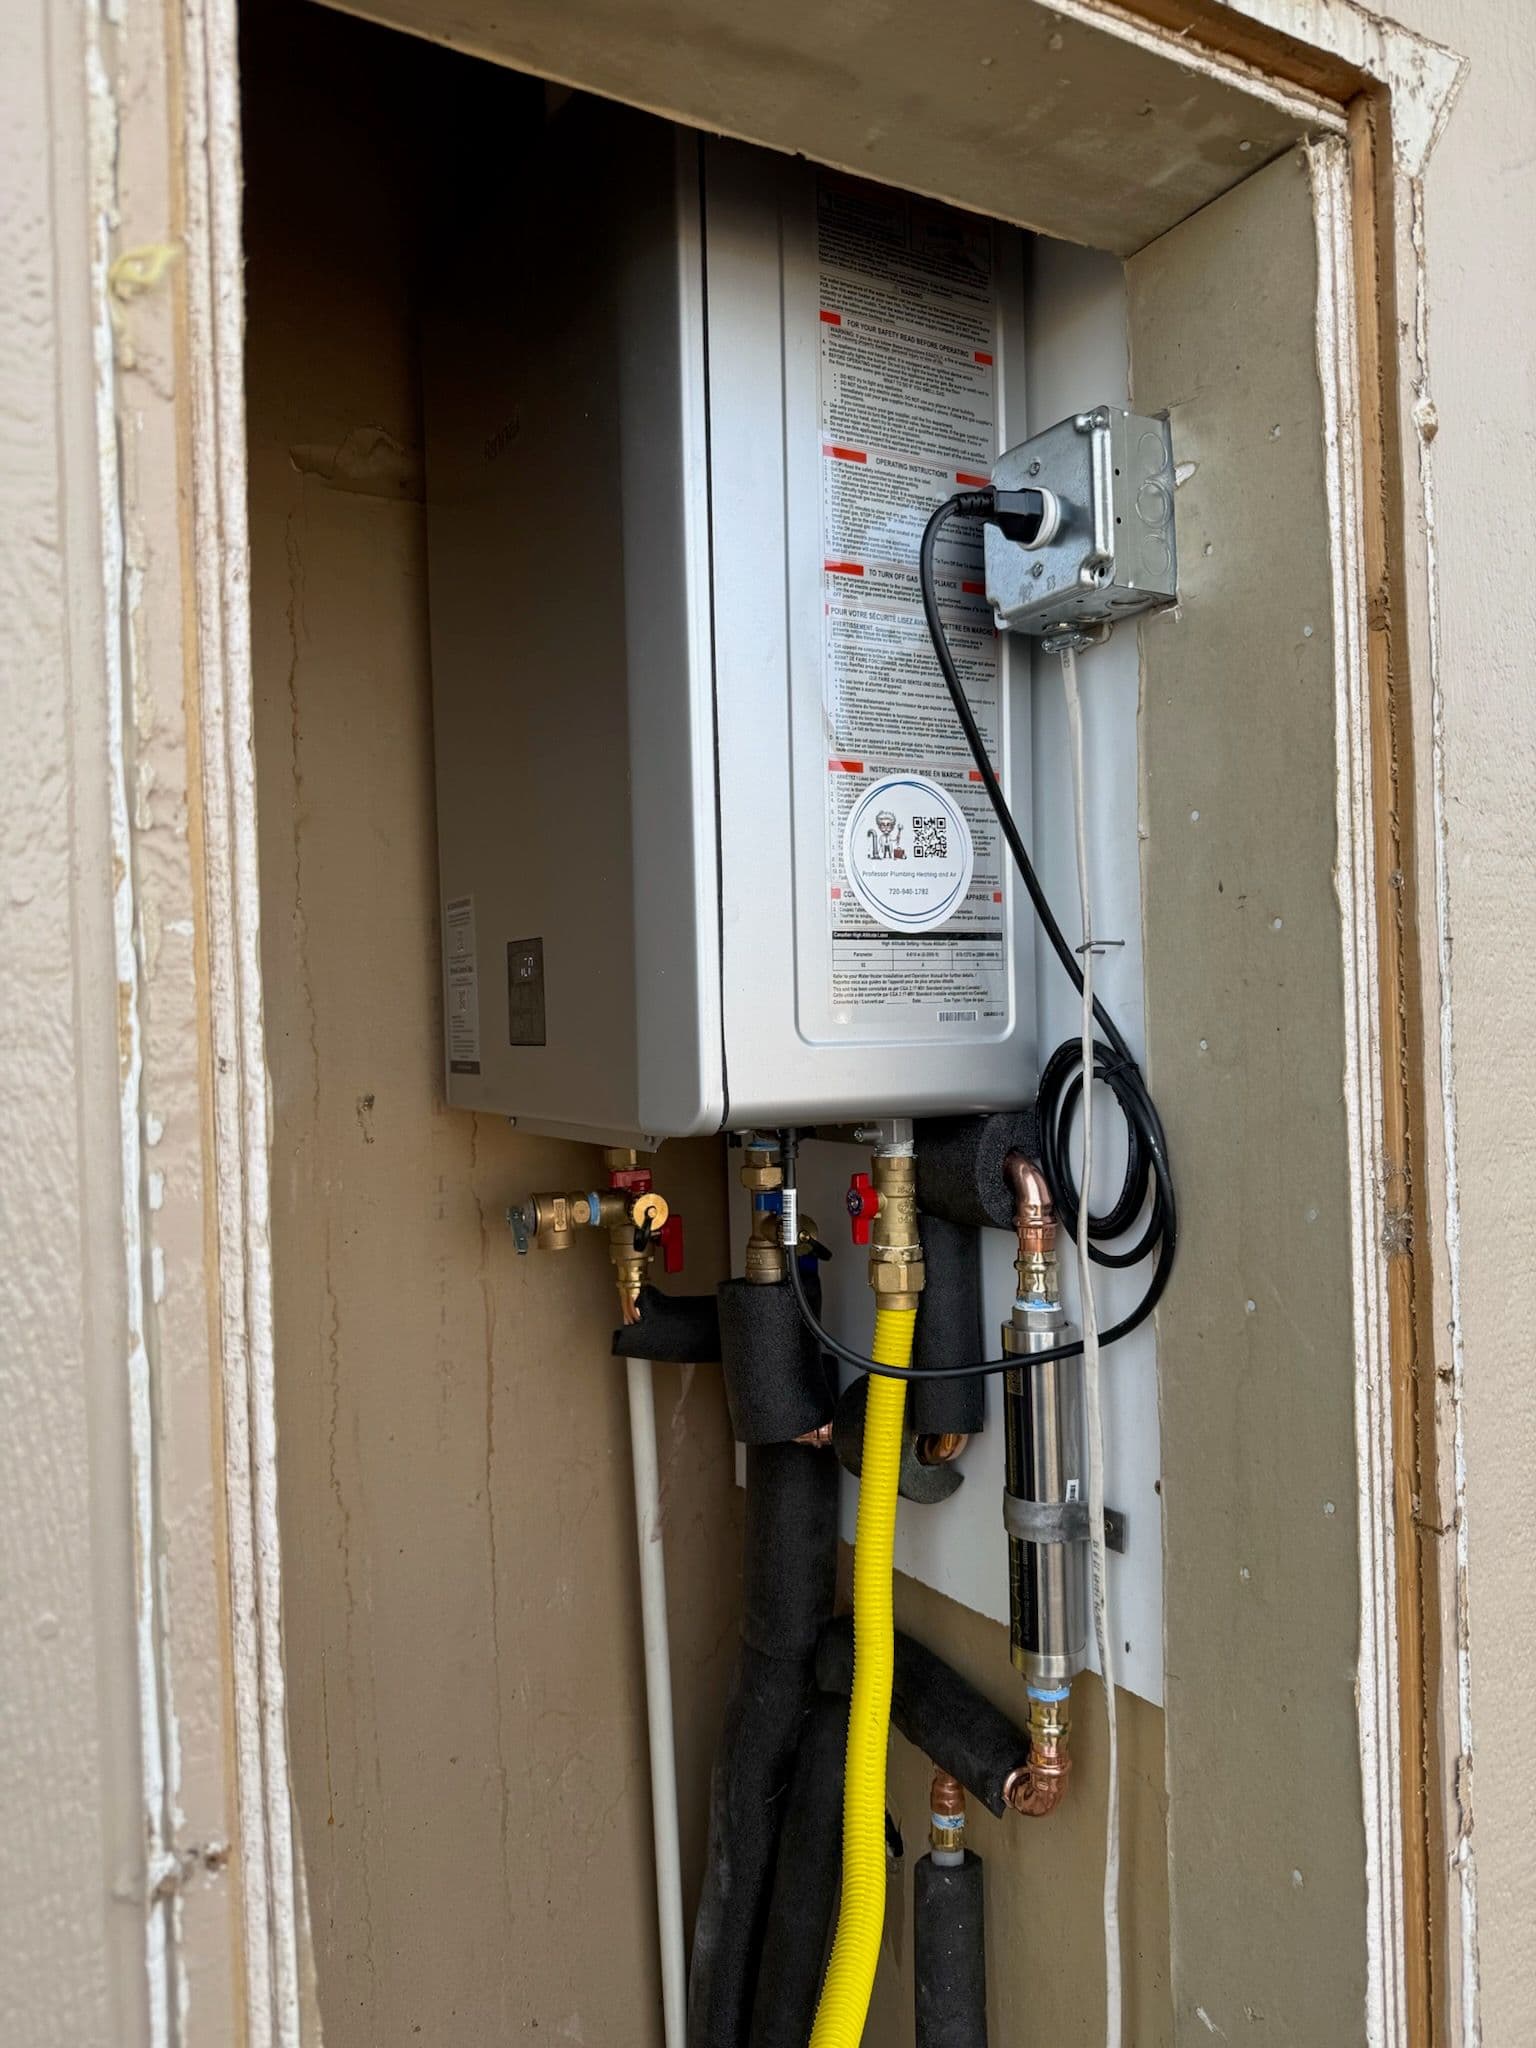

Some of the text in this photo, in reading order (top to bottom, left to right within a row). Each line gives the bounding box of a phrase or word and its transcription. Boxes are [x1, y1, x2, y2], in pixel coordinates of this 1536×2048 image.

[848, 319, 969, 358] FOR YOUR SAFETY READ BEFORE OPERATING
[876, 457, 948, 479] OPERATING INSTRUCTIONS
[869, 569, 957, 589] TO TURN OFF GAS PLIANCE
[831, 606, 848, 616] POUR
[849, 609, 867, 618] VOTRE
[869, 610, 896, 622] SÉCURITÉ
[897, 616, 913, 625] LISEZ
[870, 766, 909, 775] INSTRUCTIONS
